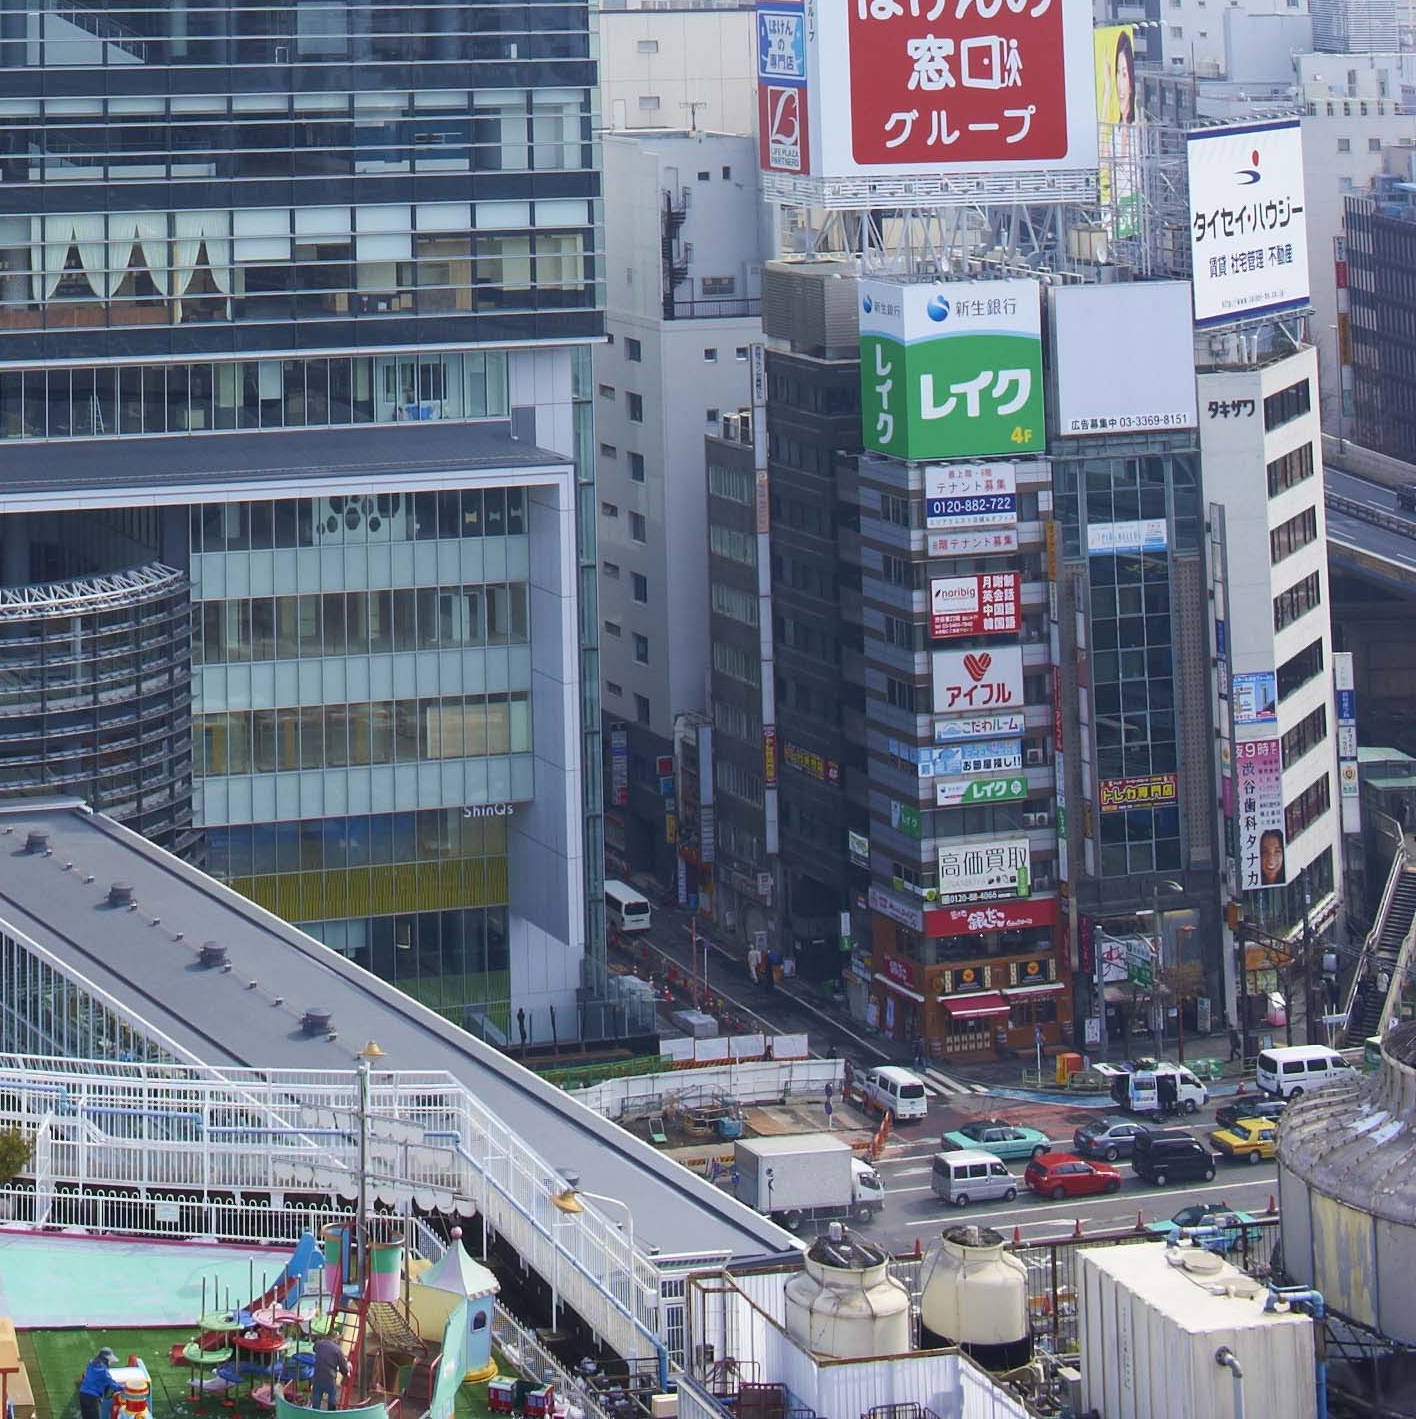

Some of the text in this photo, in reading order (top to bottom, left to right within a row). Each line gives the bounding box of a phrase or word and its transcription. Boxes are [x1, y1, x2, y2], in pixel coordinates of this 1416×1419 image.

[768, 19, 793, 36] ほけん
[884, 104, 1037, 148] グループ
[1230, 248, 1265, 275] 社宅管理
[1268, 243, 1294, 267] 不動産
[954, 297, 1017, 317] 新生銀行
[875, 343, 894, 445] レイク
[919, 368, 1032, 420] レイク
[1207, 399, 1256, 419] タキザワ
[1071, 413, 1188, 431] 広告募集中 03-3369-8151
[1010, 425, 1033, 444] 4F
[936, 478, 1006, 494] テナント募集
[933, 496, 1011, 514] 0120-882-722
[941, 586, 976, 598] noribig
[945, 682, 1012, 708] アイフル
[962, 716, 1019, 734] こだわルーム
[972, 780, 1008, 799] レイク
[463, 803, 514, 818] ShinQs
[1242, 761, 1260, 887] 渋谷歯科タナカ
[940, 846, 1027, 878] 高価買取
